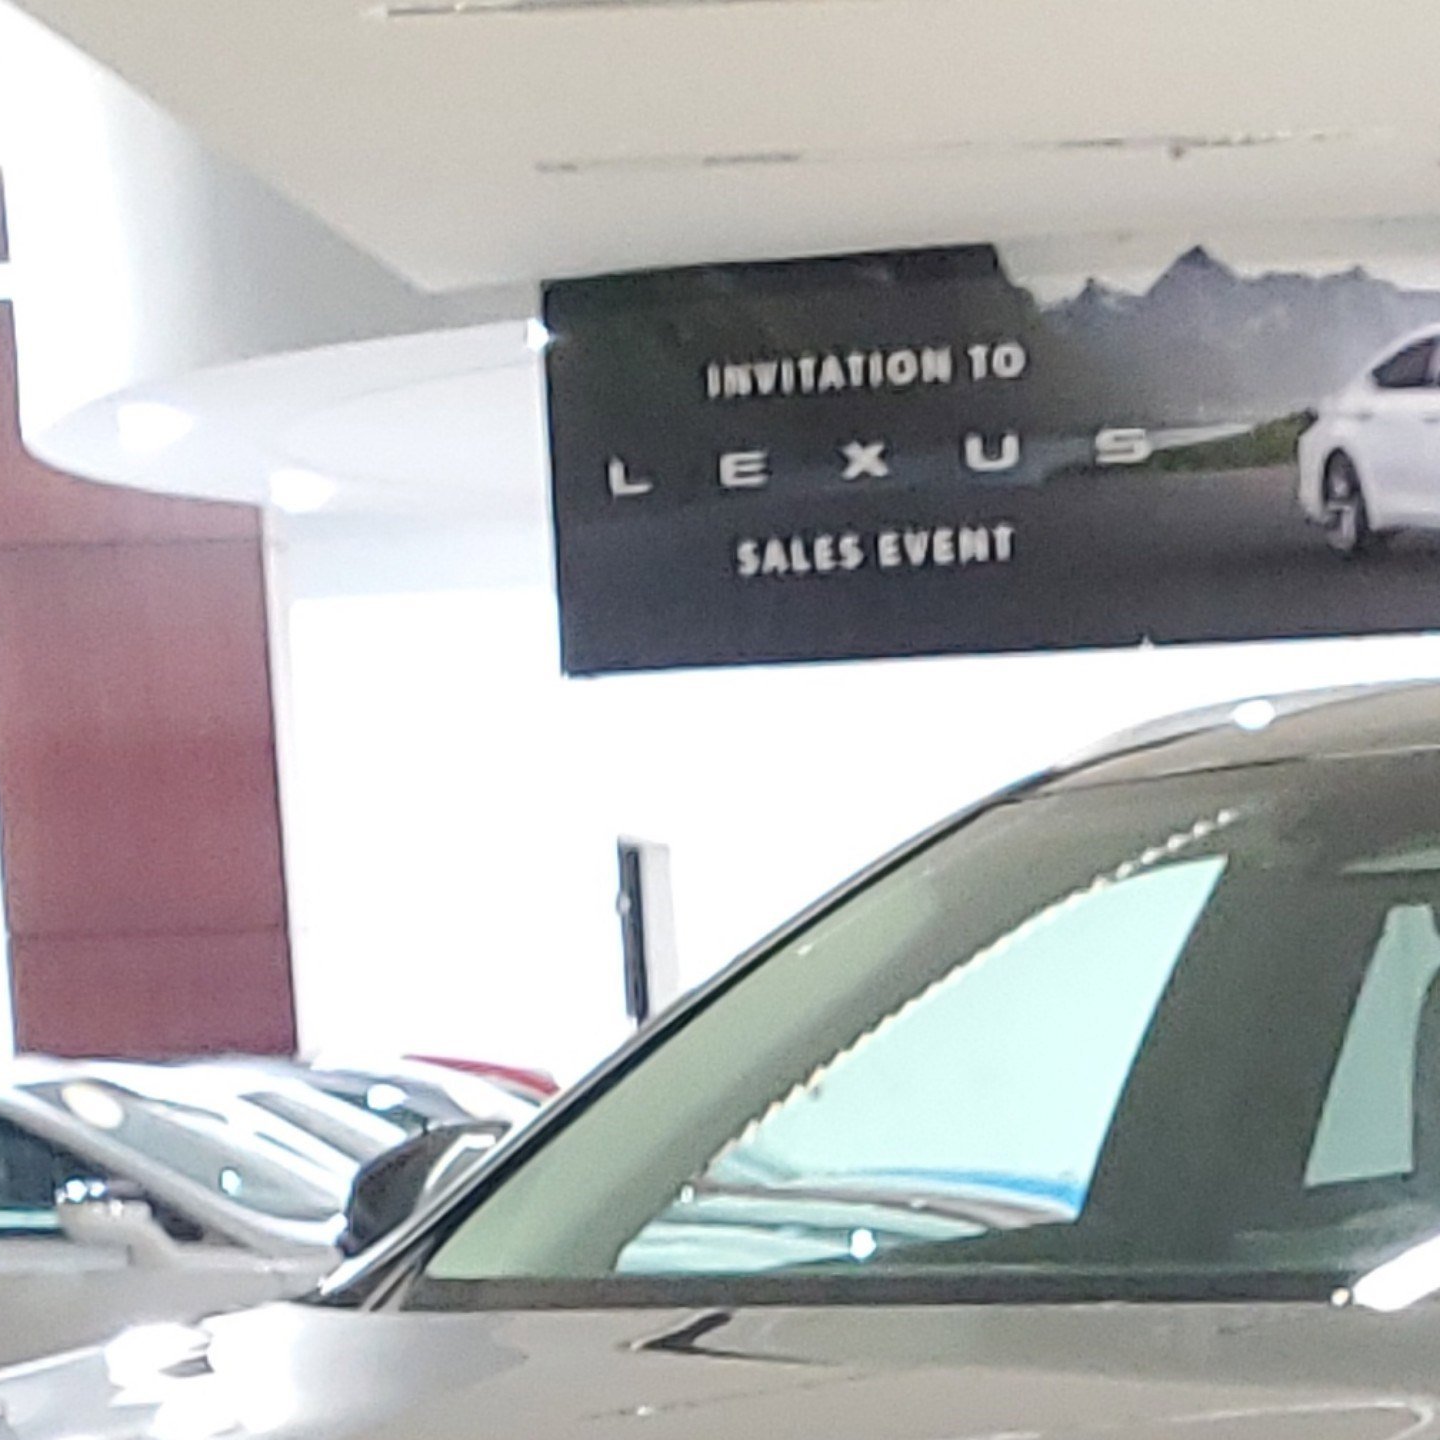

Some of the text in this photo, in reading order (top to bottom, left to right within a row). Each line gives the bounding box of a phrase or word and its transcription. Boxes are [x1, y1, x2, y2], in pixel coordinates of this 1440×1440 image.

[707, 341, 1027, 398] INVITATION TO
[606, 425, 1153, 498] LEXUS
[736, 523, 1014, 576] SALES EVENT
